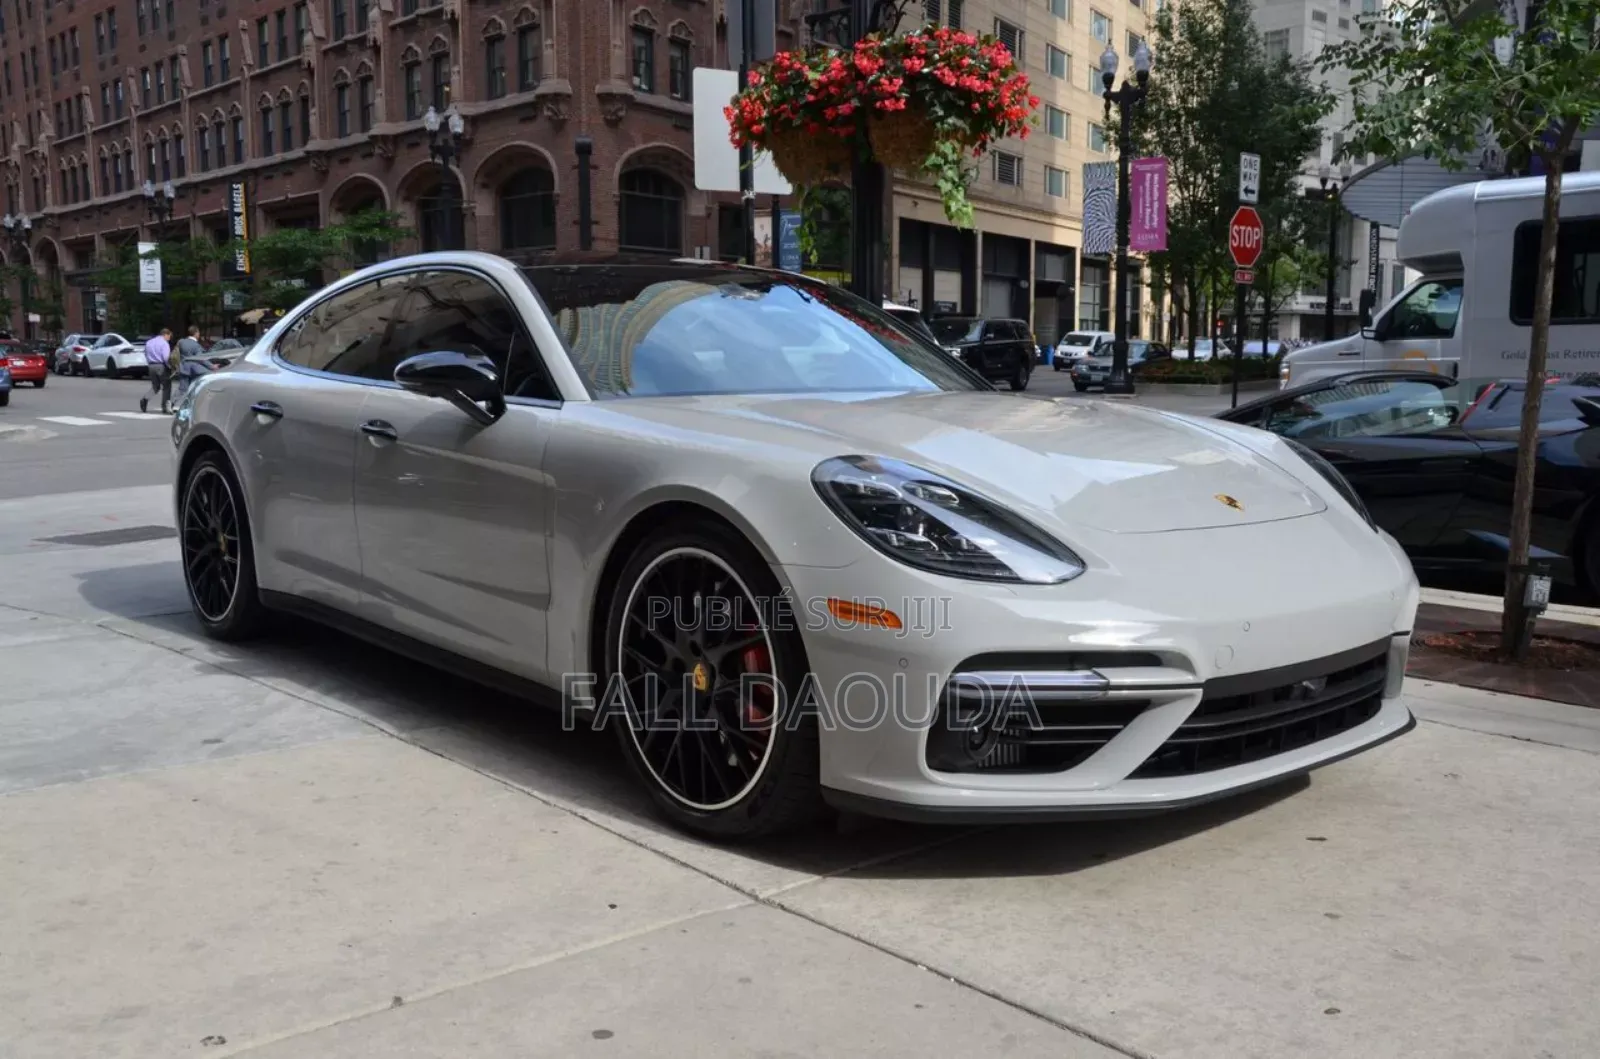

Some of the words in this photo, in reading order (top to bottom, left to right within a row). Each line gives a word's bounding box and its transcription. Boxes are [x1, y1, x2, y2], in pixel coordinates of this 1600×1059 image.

[1243, 157, 1258, 171] ONE
[1243, 172, 1258, 184] WAY
[233, 183, 242, 212] BAGELS
[1232, 225, 1260, 249] STOP
[1501, 350, 1527, 359] Gold
